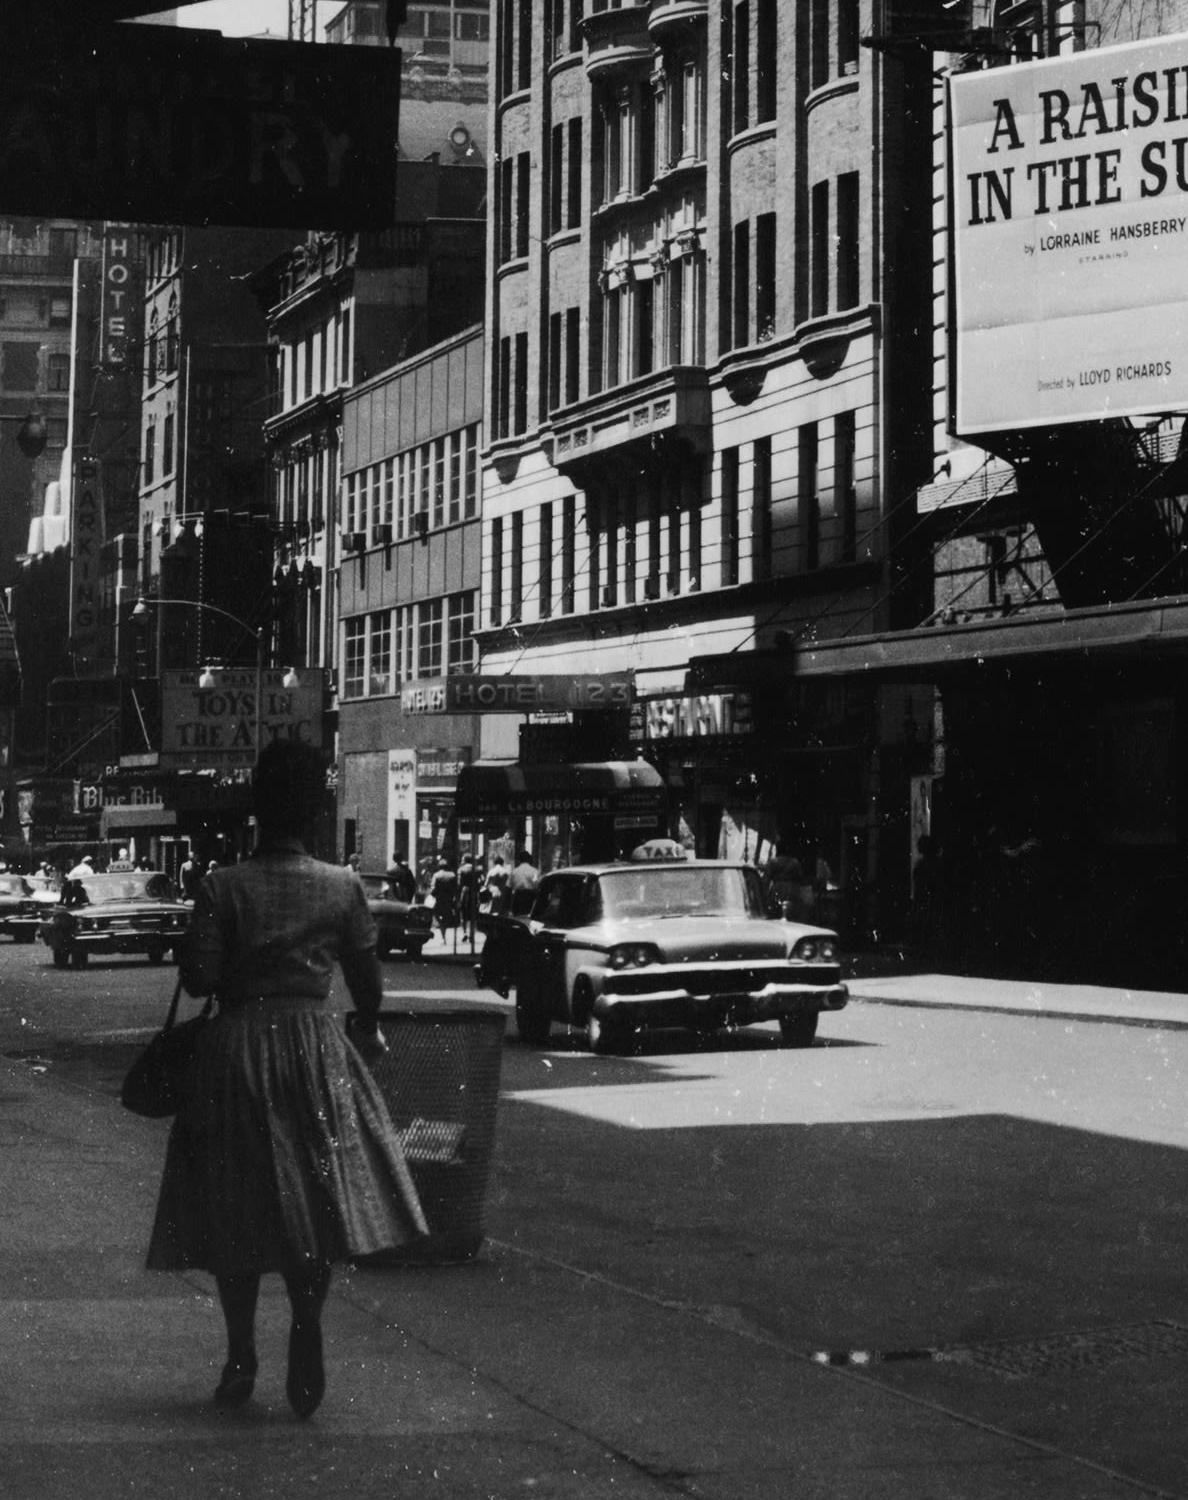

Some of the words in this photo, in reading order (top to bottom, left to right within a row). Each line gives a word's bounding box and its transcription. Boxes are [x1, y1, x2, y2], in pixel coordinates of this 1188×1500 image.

[986, 97, 1026, 155] A
[966, 166, 1015, 226] IN
[1026, 148, 1123, 216] THE
[1024, 242, 1036, 255] by
[1040, 229, 1101, 252] LORRAINE
[1110, 217, 1187, 243] HANSBERRY
[108, 238, 128, 362] HOTEL
[1079, 368, 1111, 387] LLOYD
[1116, 360, 1172, 382] RICHARDS
[76, 464, 96, 628] PARKING
[192, 690, 255, 717] TOYS
[268, 692, 294, 716] IN
[455, 683, 555, 704] HOTEL
[176, 721, 224, 747] THE
[526, 797, 609, 811] BOURGOGNE
